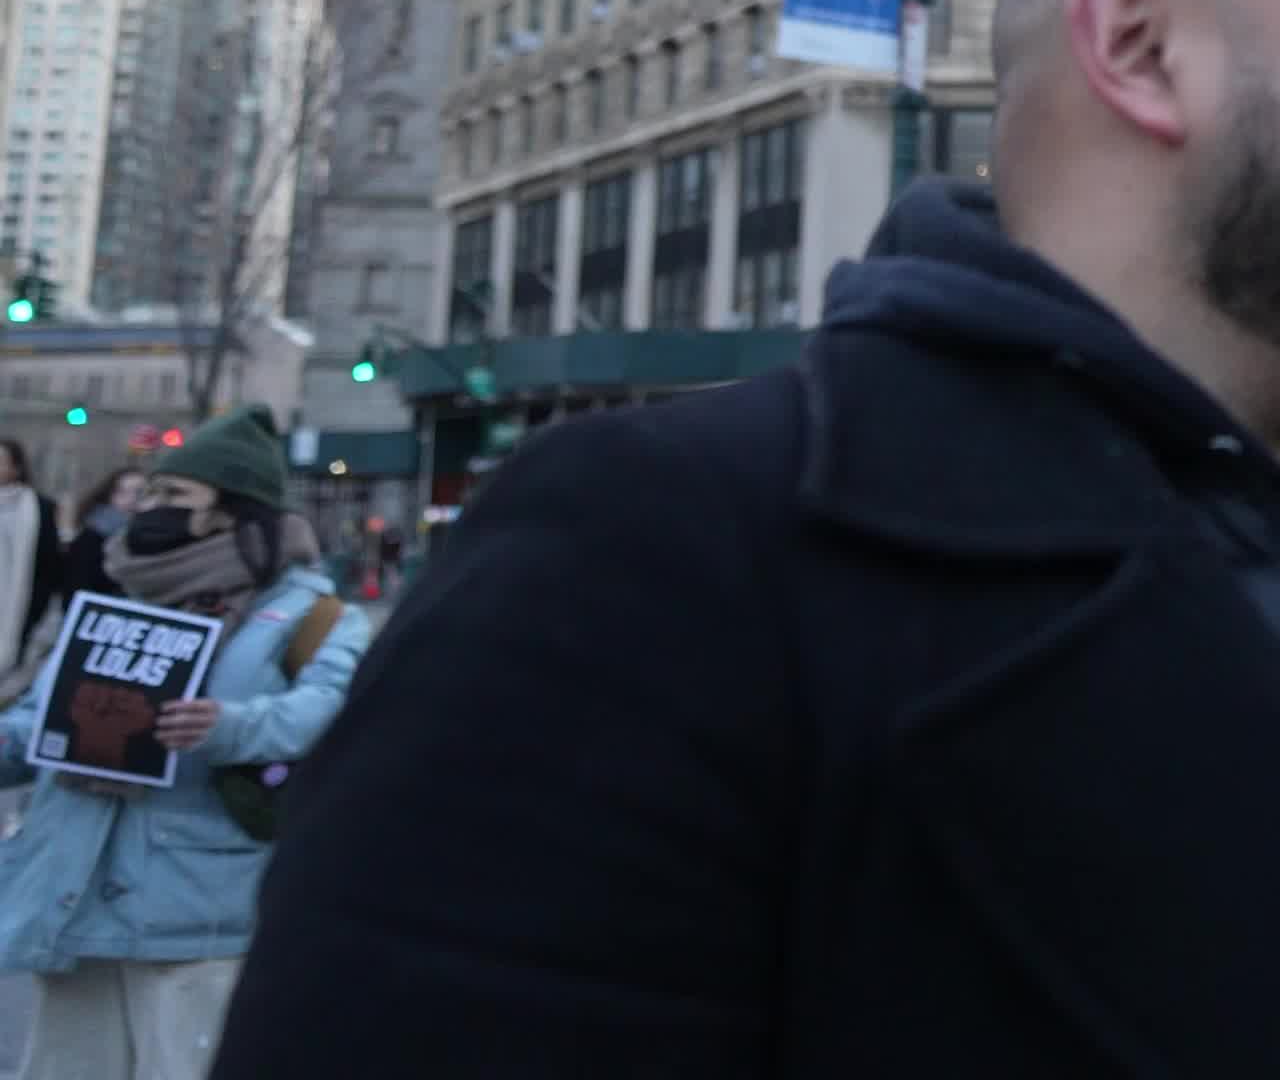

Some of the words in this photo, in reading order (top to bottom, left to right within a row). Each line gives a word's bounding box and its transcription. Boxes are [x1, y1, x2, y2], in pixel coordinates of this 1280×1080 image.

[77, 610, 151, 651] LOVE
[142, 623, 204, 662] OUR
[84, 644, 175, 687] LOLAS
